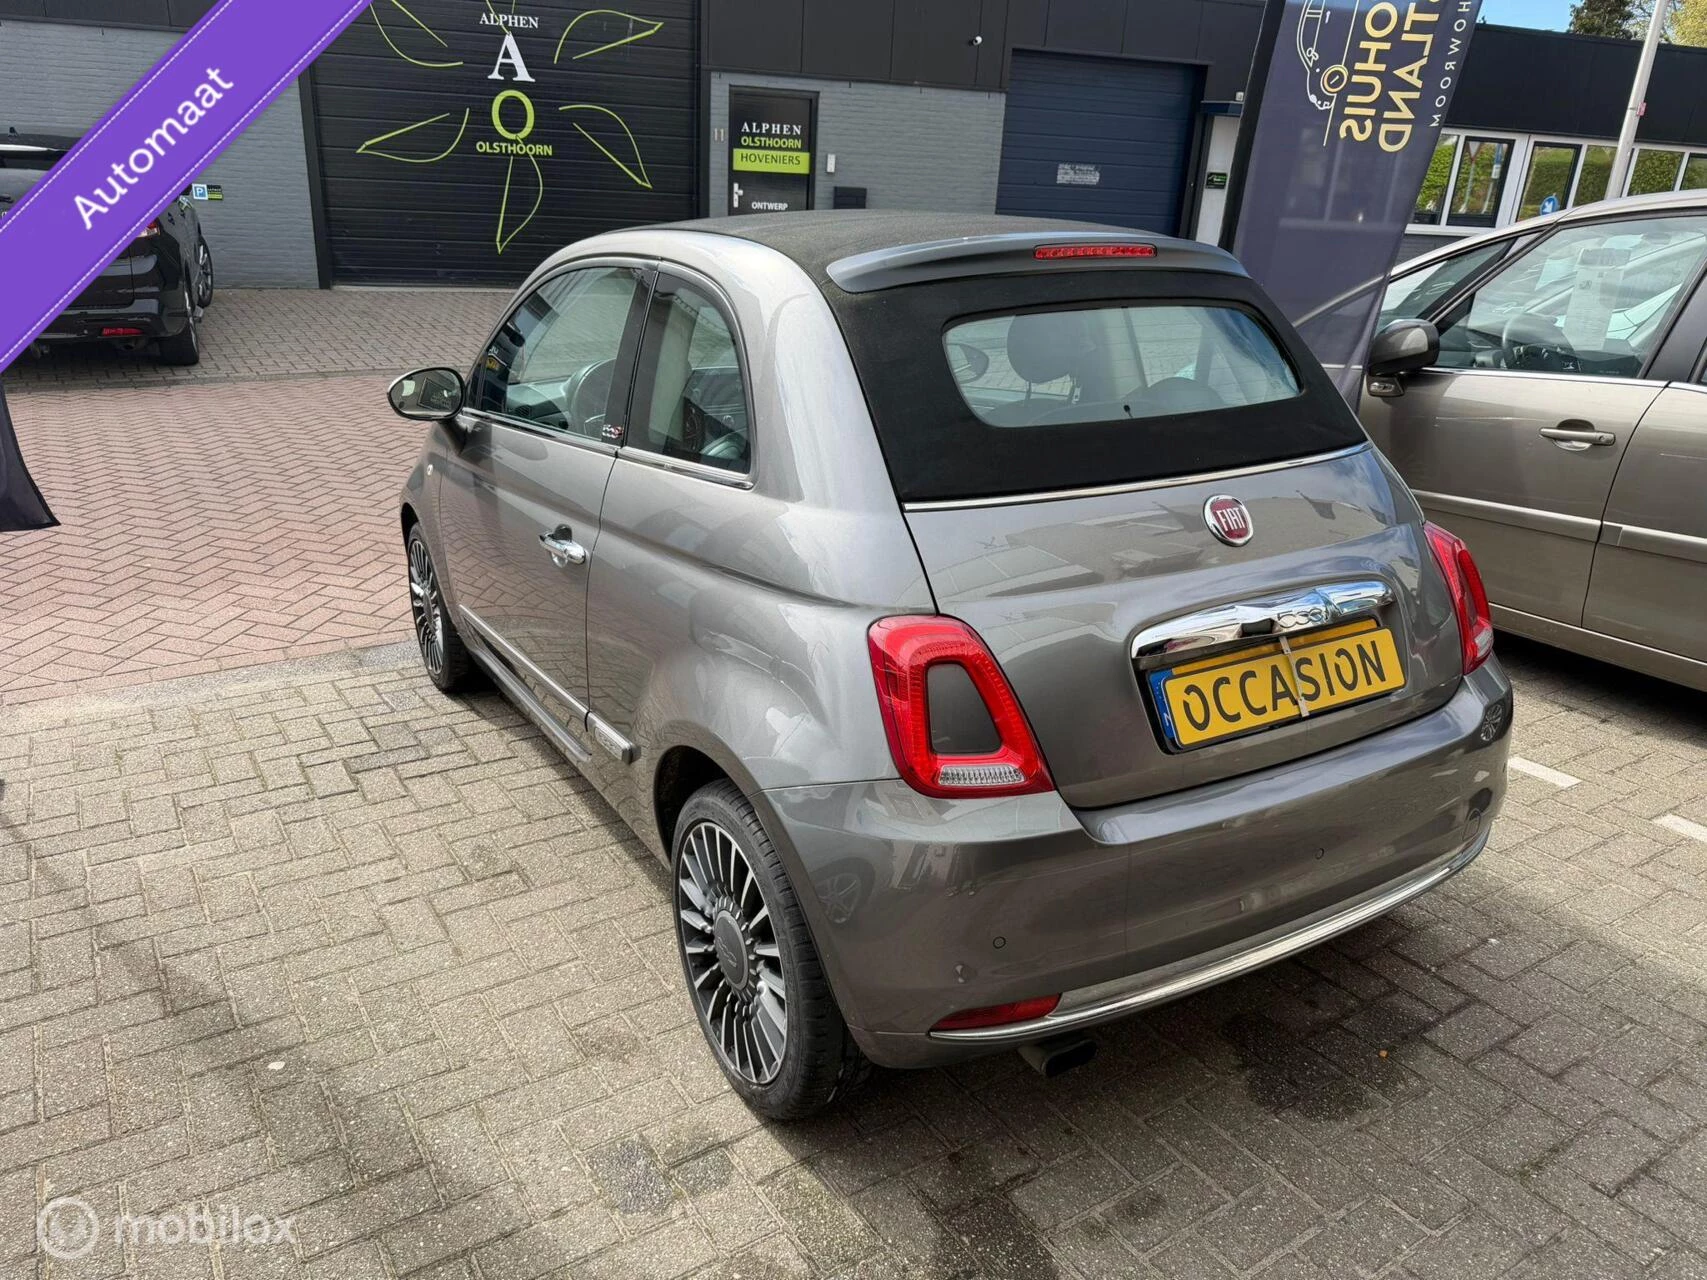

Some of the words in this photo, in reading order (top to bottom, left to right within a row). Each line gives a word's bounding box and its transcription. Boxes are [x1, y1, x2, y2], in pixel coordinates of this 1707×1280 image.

[479, 12, 539, 29] ALPHEN
[487, 31, 536, 83] A
[491, 89, 535, 140] O
[741, 121, 802, 136] ALPHEN
[475, 140, 553, 156] OLSTHOORN
[740, 136, 802, 149] OLSTHOORN
[740, 152, 801, 166] HOVENIERS
[751, 201, 788, 211] ONTWERP
[1216, 507, 1246, 532] FIAT
[1182, 640, 1387, 732] OCCASION
